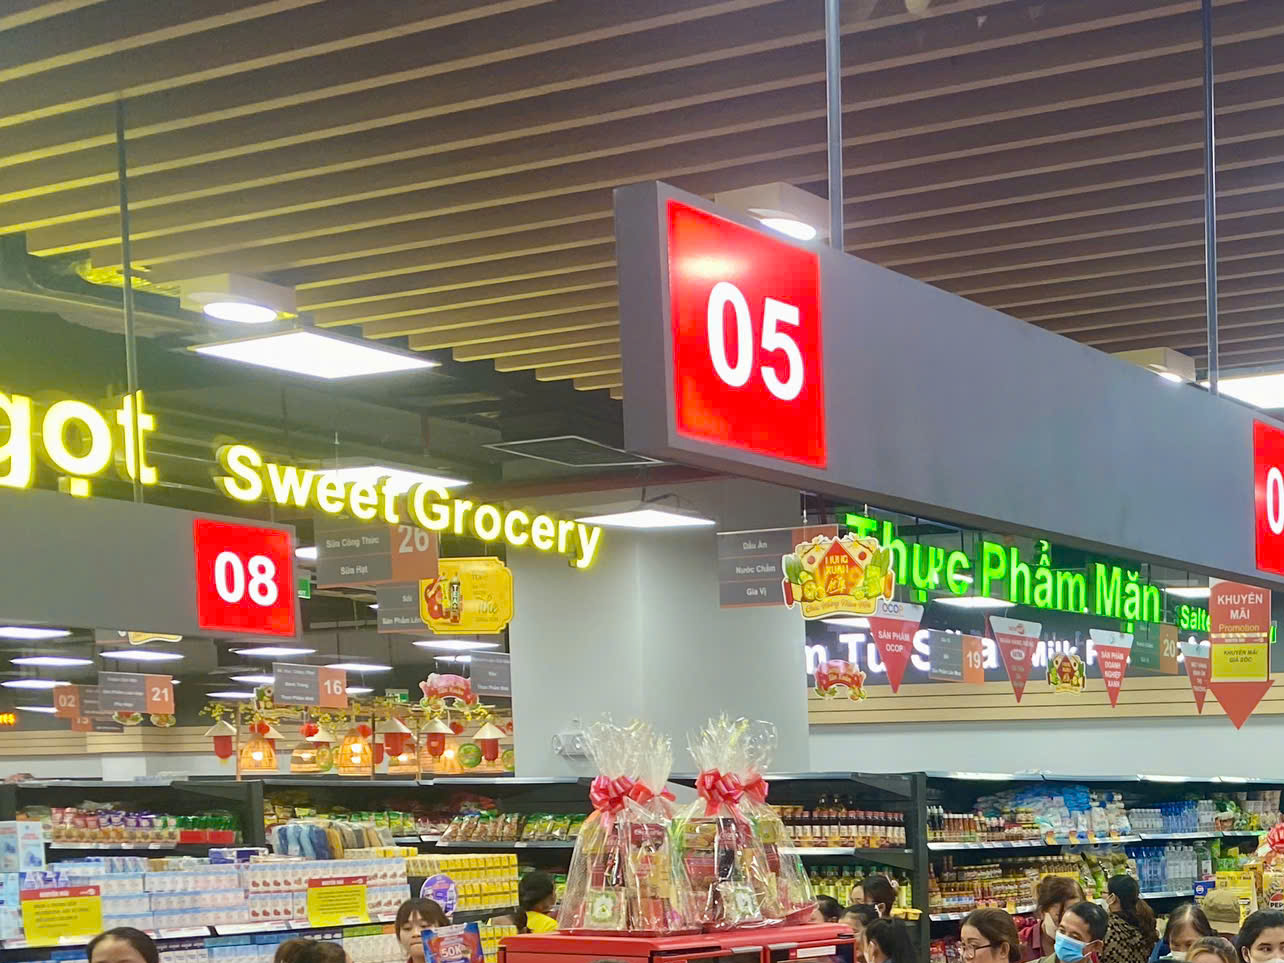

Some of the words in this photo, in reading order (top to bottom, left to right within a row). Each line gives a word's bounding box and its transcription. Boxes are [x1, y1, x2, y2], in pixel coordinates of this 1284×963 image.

[707, 281, 805, 402] 05
[222, 444, 401, 523] Sweet
[413, 484, 601, 569] Grocery
[398, 524, 430, 553] 26
[214, 550, 279, 607] 08
[845, 513, 974, 603] Thực
[981, 539, 1087, 612] Phẩm
[1094, 562, 1161, 633] Mặn
[1217, 592, 1264, 605] KHUYẾN
[966, 650, 982, 670] 19
[1163, 638, 1176, 658] 20
[151, 687, 169, 702] 21
[323, 679, 343, 696] 16
